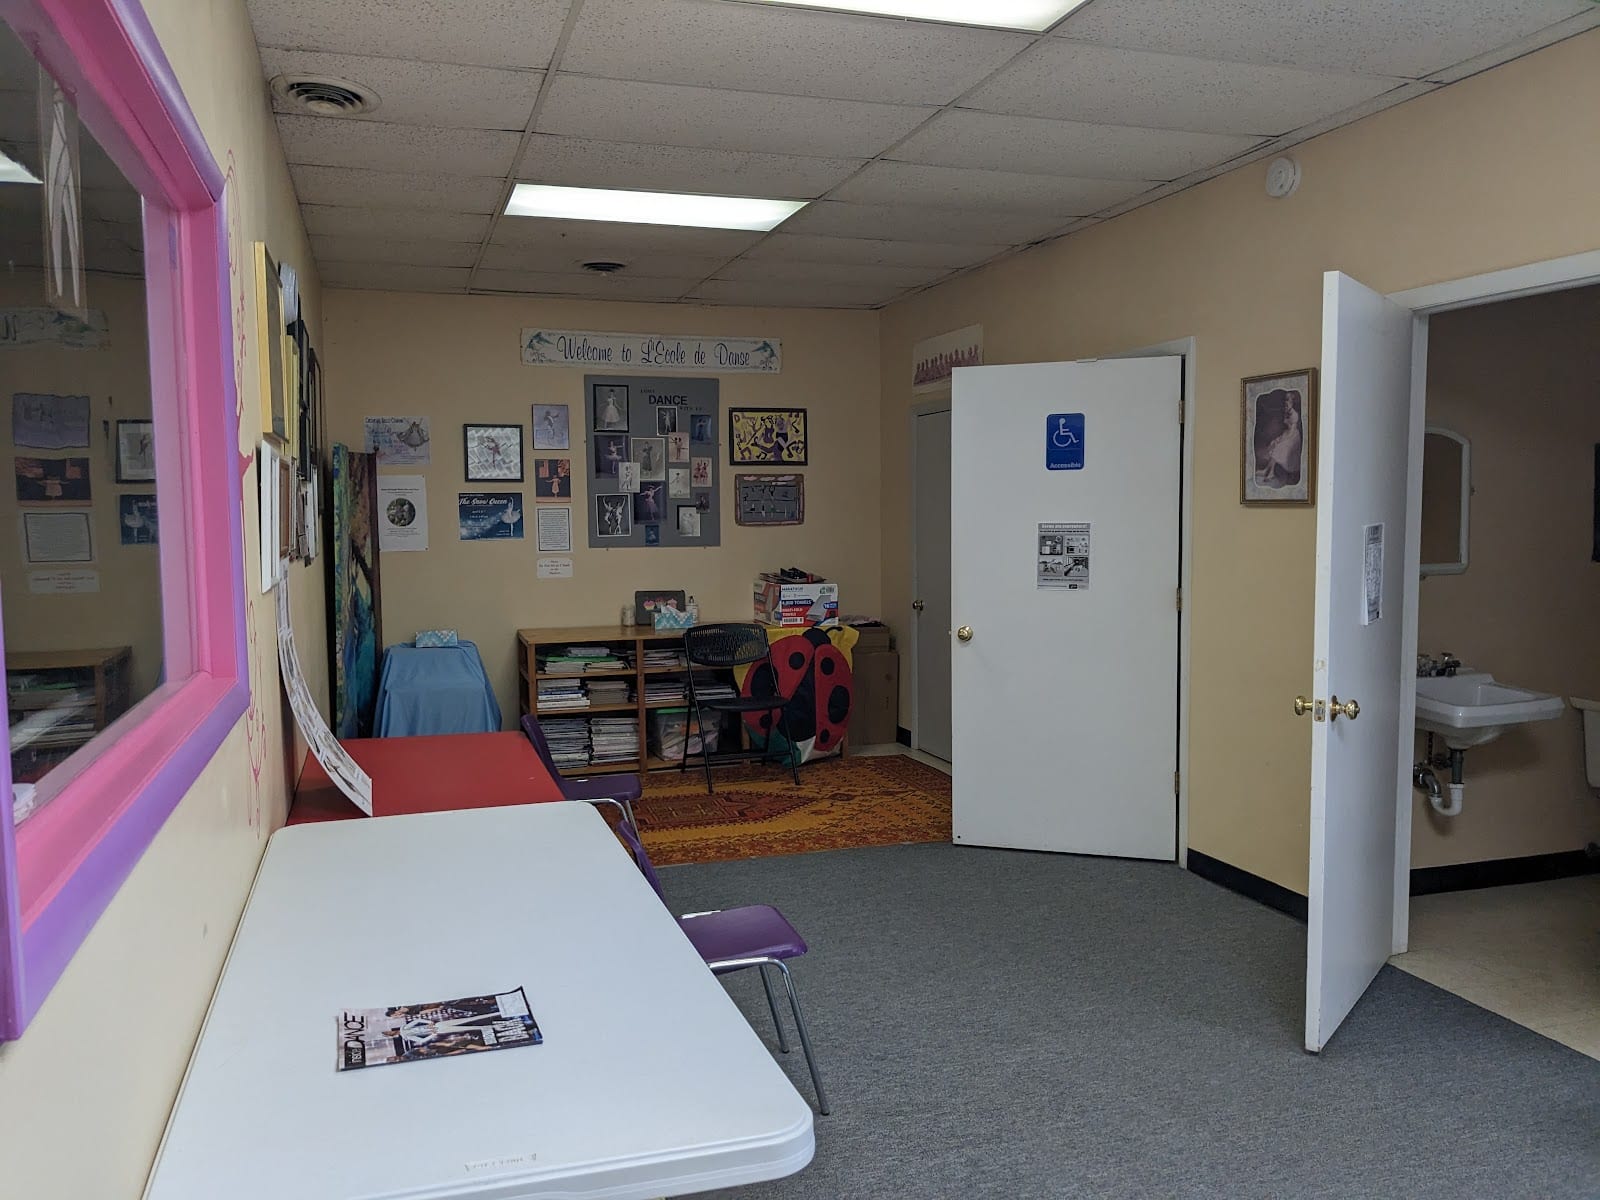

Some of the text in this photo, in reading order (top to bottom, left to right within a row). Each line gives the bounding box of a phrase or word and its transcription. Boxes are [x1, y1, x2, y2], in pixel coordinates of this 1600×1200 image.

[556, 335, 750, 366] Welcome to L'Ecole de Danse
[648, 395, 688, 405] DANCE
[459, 497, 470, 505] The
[471, 498, 488, 506] Snow
[344, 1011, 365, 1049] DANCE
